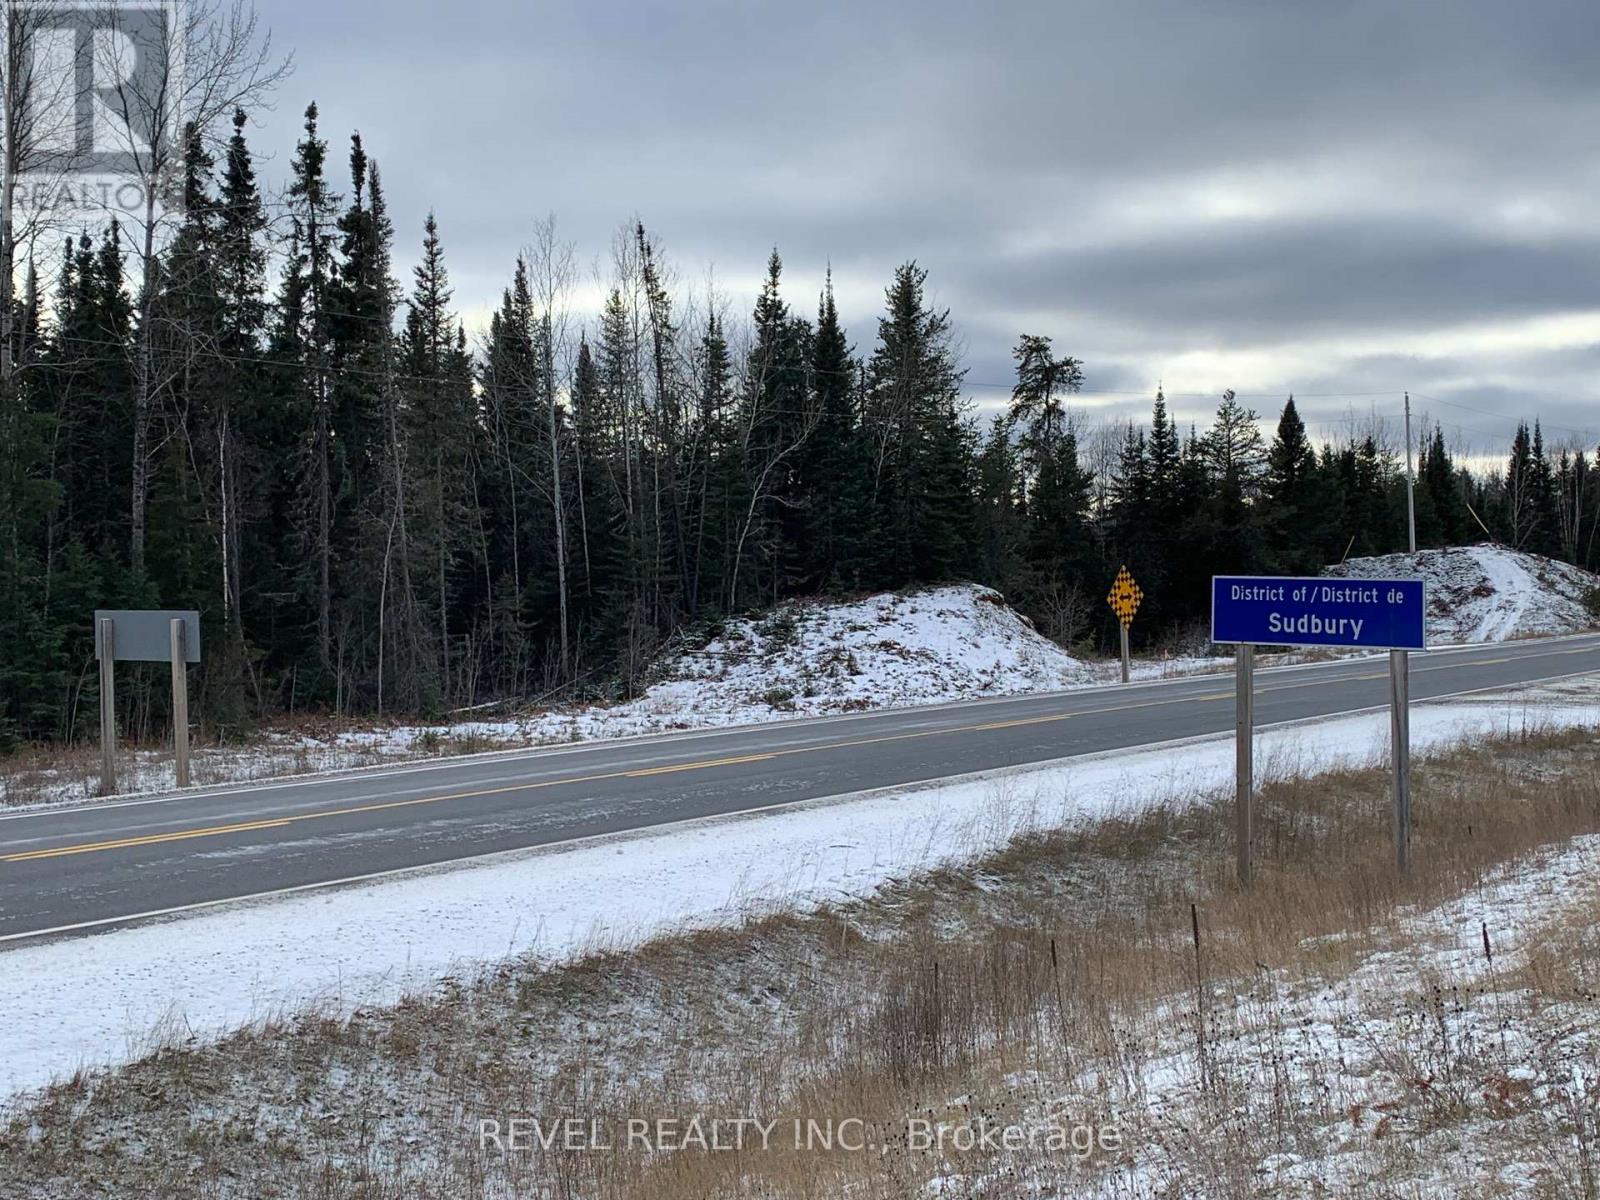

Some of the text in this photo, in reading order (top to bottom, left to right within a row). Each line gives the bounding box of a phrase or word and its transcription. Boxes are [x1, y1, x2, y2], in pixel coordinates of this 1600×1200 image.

[1231, 585, 1284, 601] District
[1387, 588, 1404, 604] de
[1268, 612, 1364, 640] Sudbury
